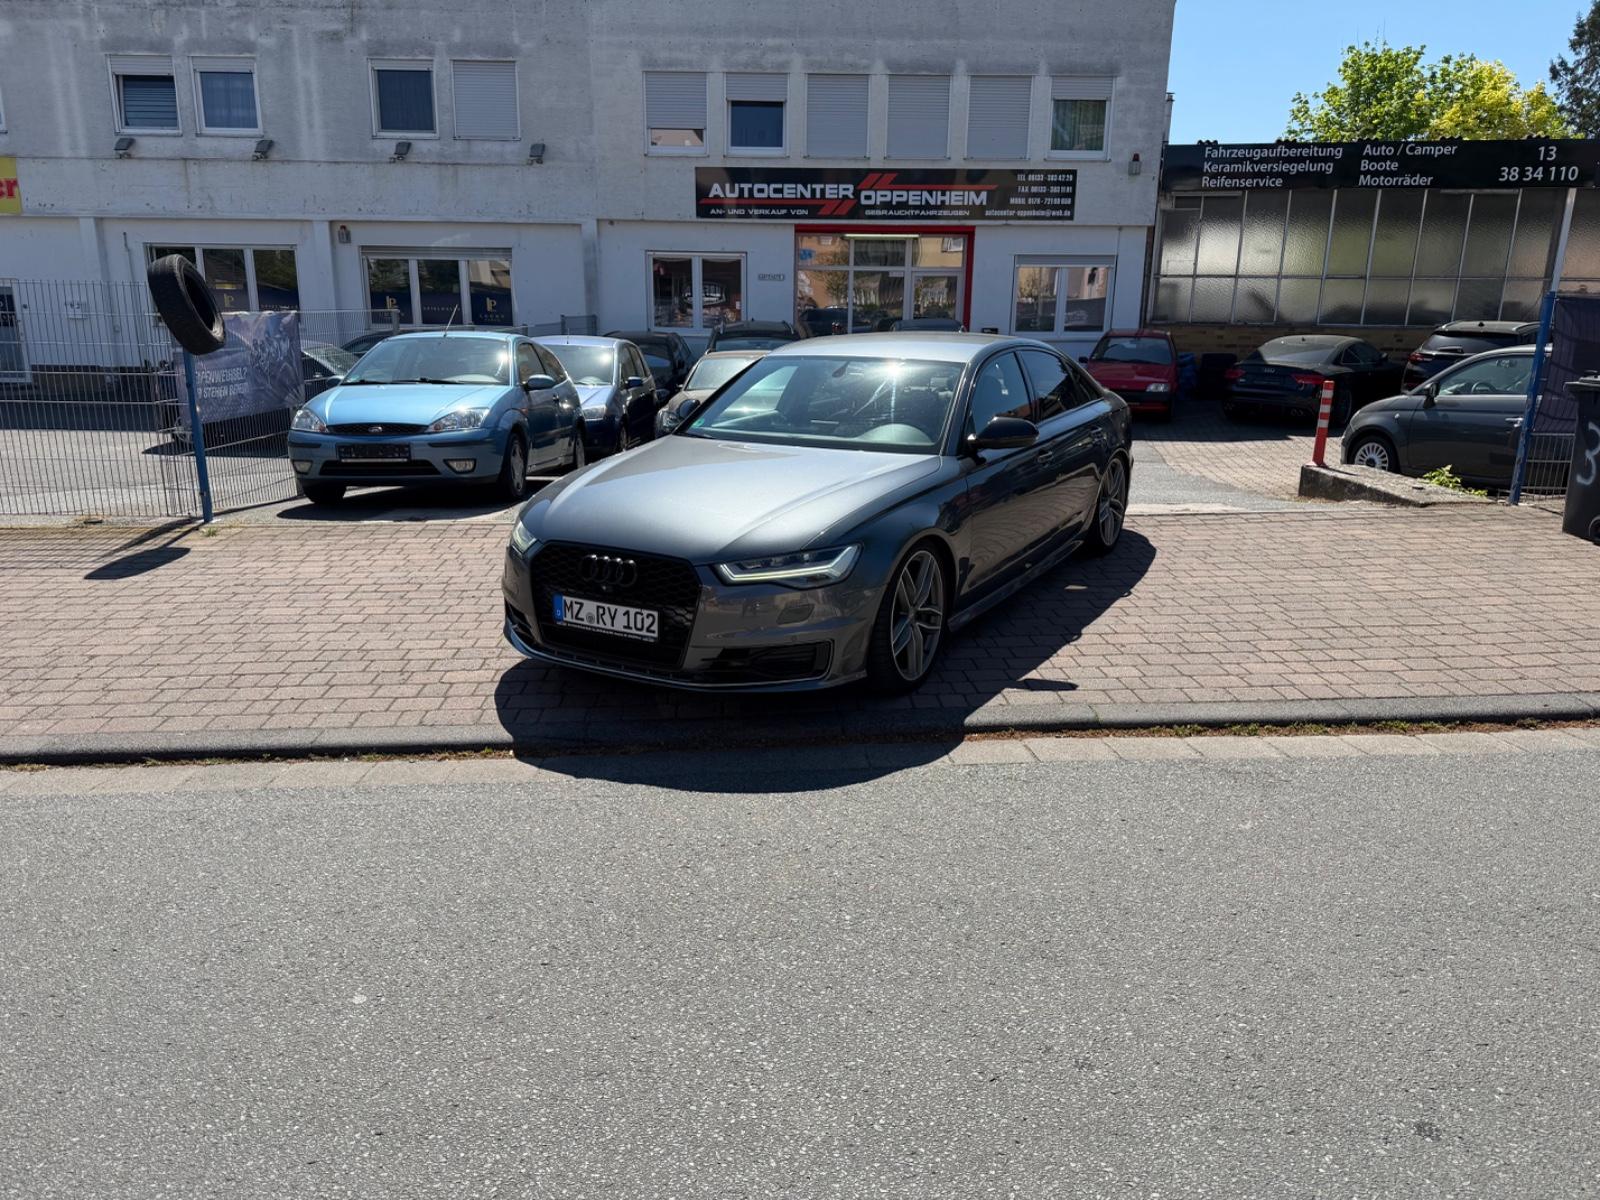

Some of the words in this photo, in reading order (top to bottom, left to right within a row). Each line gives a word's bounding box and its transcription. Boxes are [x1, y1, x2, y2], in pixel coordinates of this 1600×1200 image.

[1204, 145, 1343, 160] Fahrzeugaufbereitung
[1362, 144, 1395, 156] Auto
[1405, 144, 1458, 158] Camper
[1538, 146, 1557, 161] 13
[1203, 160, 1334, 174] Keramikversiegelung
[1360, 160, 1399, 171] Boote
[1358, 173, 1433, 186] Motorräder
[1499, 166, 1519, 181] 38
[1523, 166, 1543, 181] 34
[1549, 166, 1579, 181] 110
[1201, 176, 1283, 188] Reifenservice
[708, 183, 854, 199] AUTOCENTER
[860, 190, 988, 206] OPPENHEIM
[563, 599, 585, 622] MZ
[596, 605, 618, 628] RY
[622, 610, 656, 634] 102
